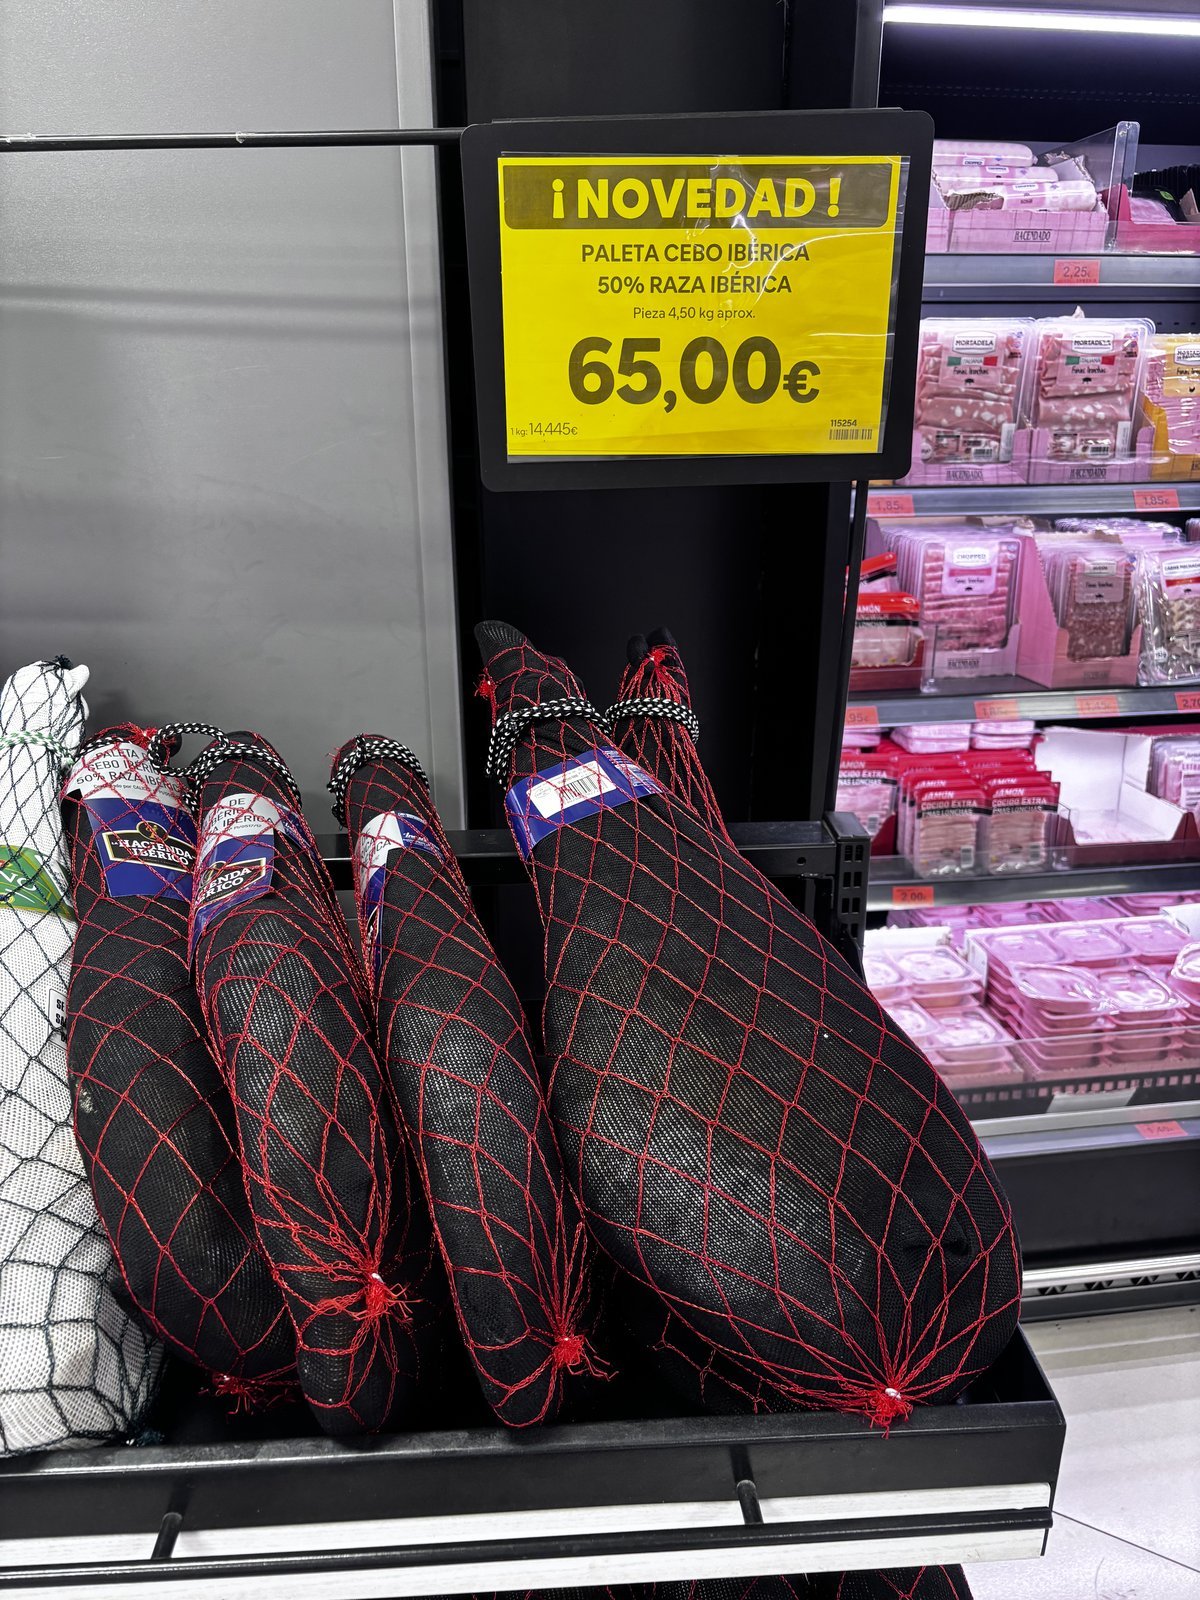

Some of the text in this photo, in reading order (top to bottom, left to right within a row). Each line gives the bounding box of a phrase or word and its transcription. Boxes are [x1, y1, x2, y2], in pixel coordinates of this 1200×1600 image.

[1014, 230, 1051, 241] HACENDADO
[581, 238, 810, 263] PALETA CEBO IBÉRICA
[597, 271, 793, 294] 50% RAZA IBÉRICA
[633, 307, 756, 321] Pieza 4,50 kg aprox.
[568, 335, 821, 414] 65,00€
[529, 422, 578, 437] 14,445€
[830, 419, 857, 427] 115254
[229, 797, 246, 806] DE
[118, 839, 193, 861] HACIENDA
